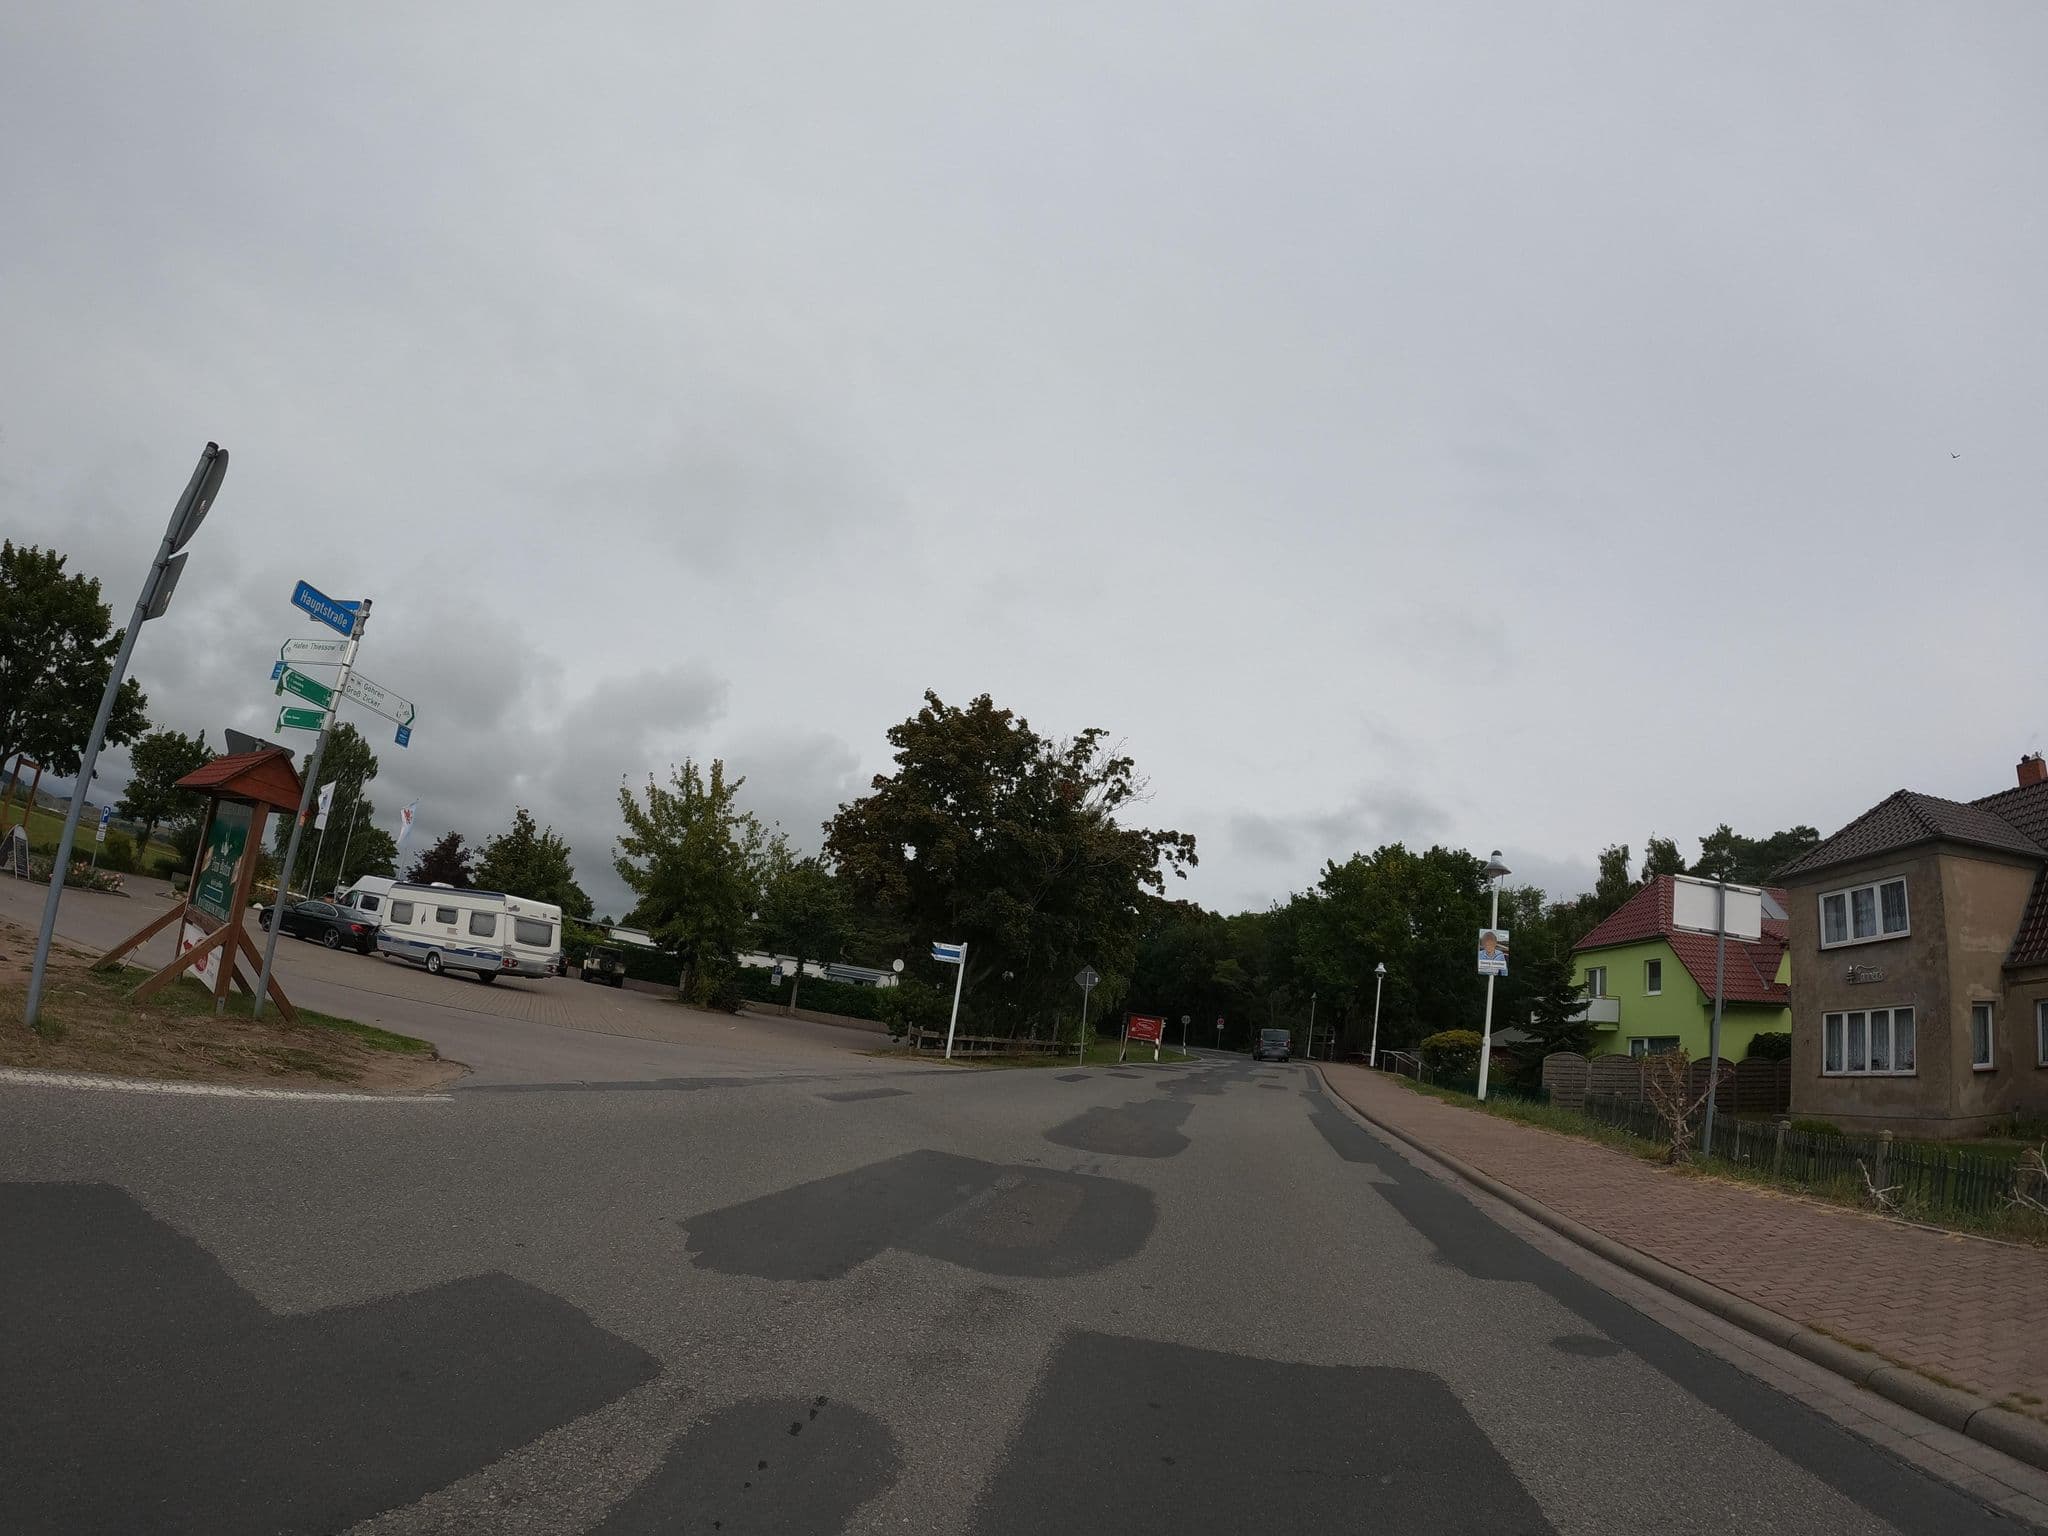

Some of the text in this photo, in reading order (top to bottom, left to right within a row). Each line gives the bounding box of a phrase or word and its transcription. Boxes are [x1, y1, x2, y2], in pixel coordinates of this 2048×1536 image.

[300, 589, 348, 627] Hauptstraße
[292, 641, 308, 650] Hafen
[346, 685, 361, 698] Groß
